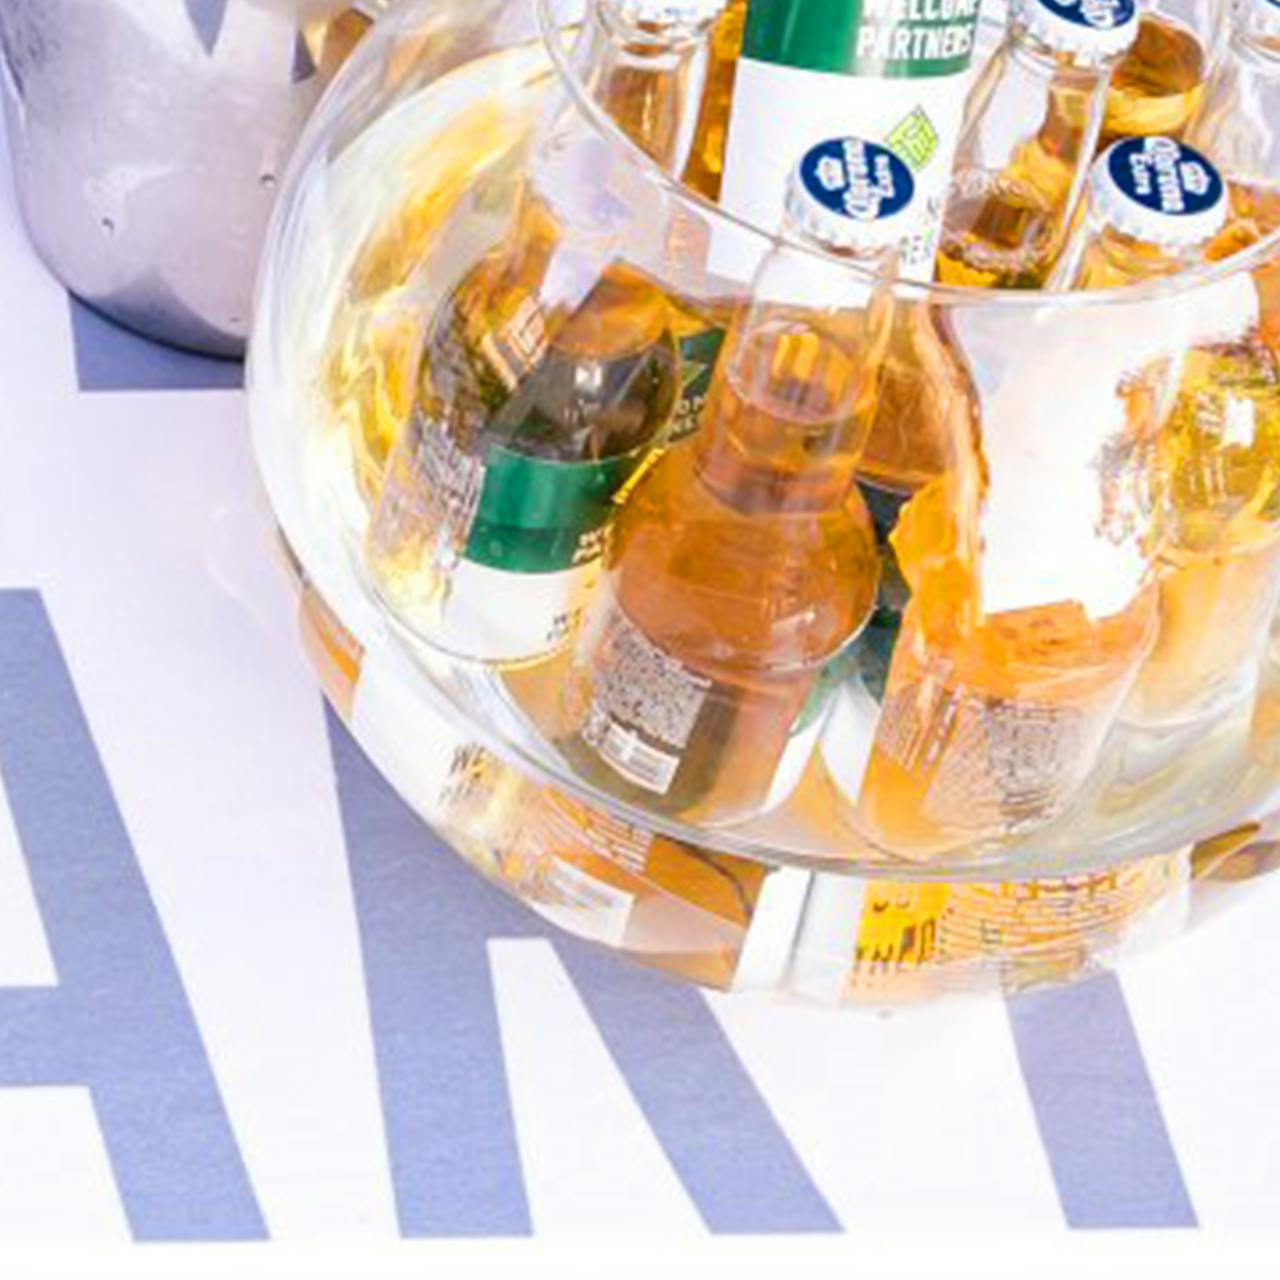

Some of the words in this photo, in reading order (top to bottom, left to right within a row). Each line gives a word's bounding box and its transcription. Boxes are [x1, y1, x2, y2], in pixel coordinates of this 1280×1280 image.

[857, 22, 974, 60] PARTNERS
[842, 140, 880, 220] Corona
[1143, 136, 1186, 212] Corona
